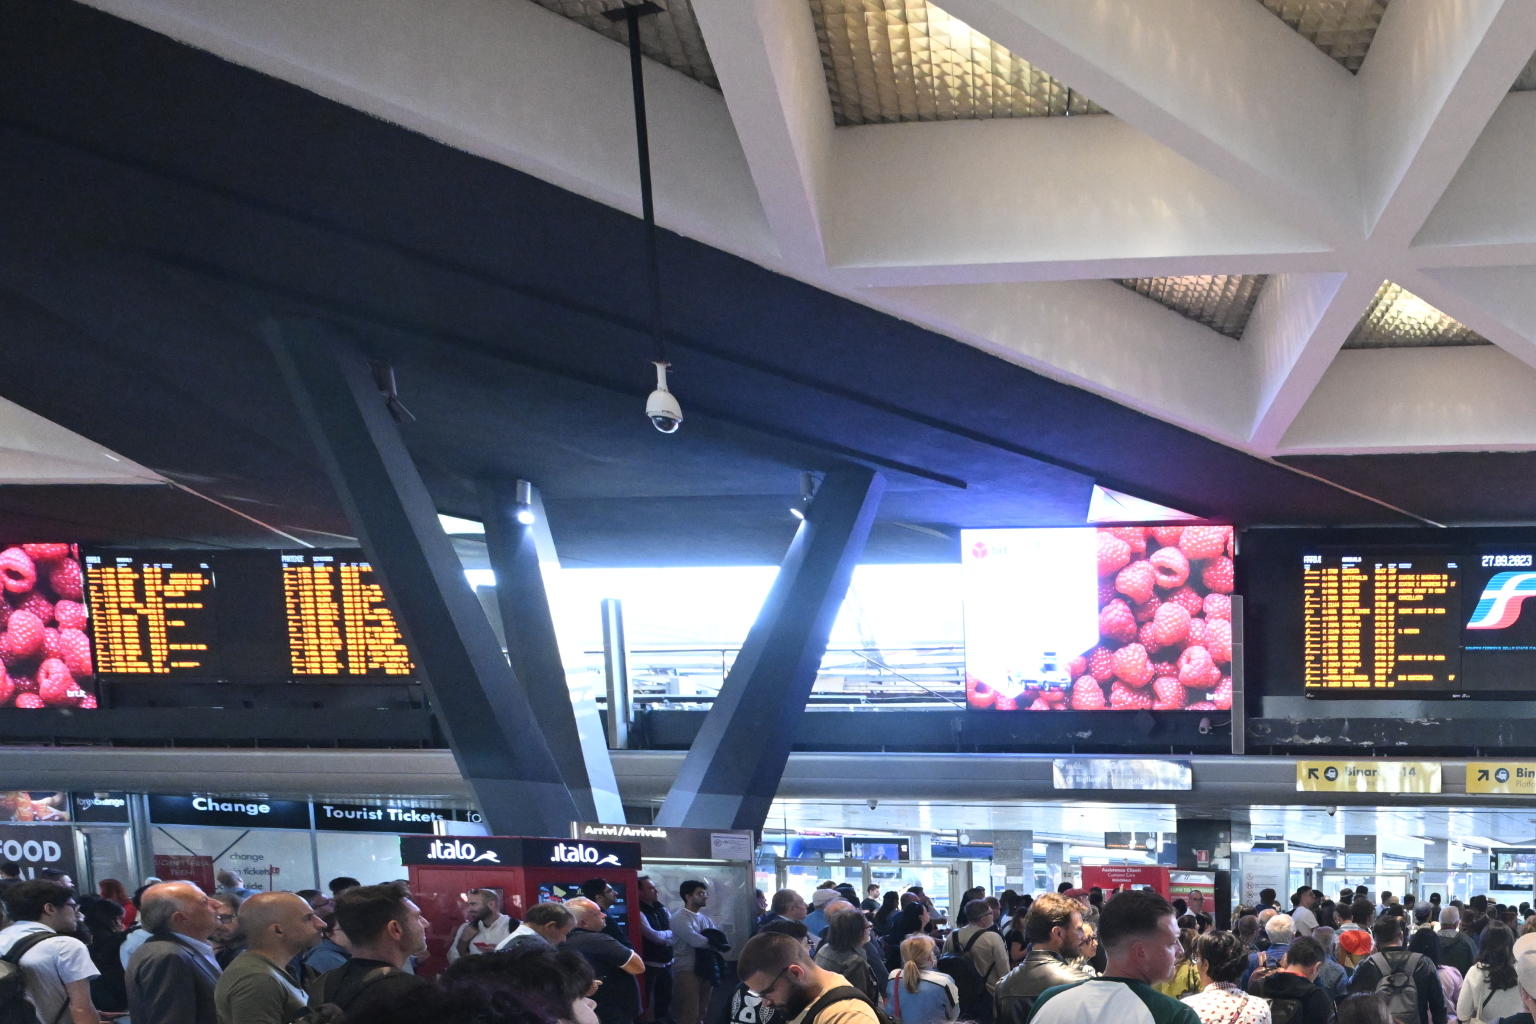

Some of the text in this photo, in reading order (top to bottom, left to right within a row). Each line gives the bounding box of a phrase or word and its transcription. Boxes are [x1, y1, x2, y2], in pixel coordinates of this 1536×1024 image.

[192, 798, 270, 815] Change
[323, 805, 444, 823] Tourist Tickets
[0, 839, 62, 862] OOD
[230, 852, 264, 863] change
